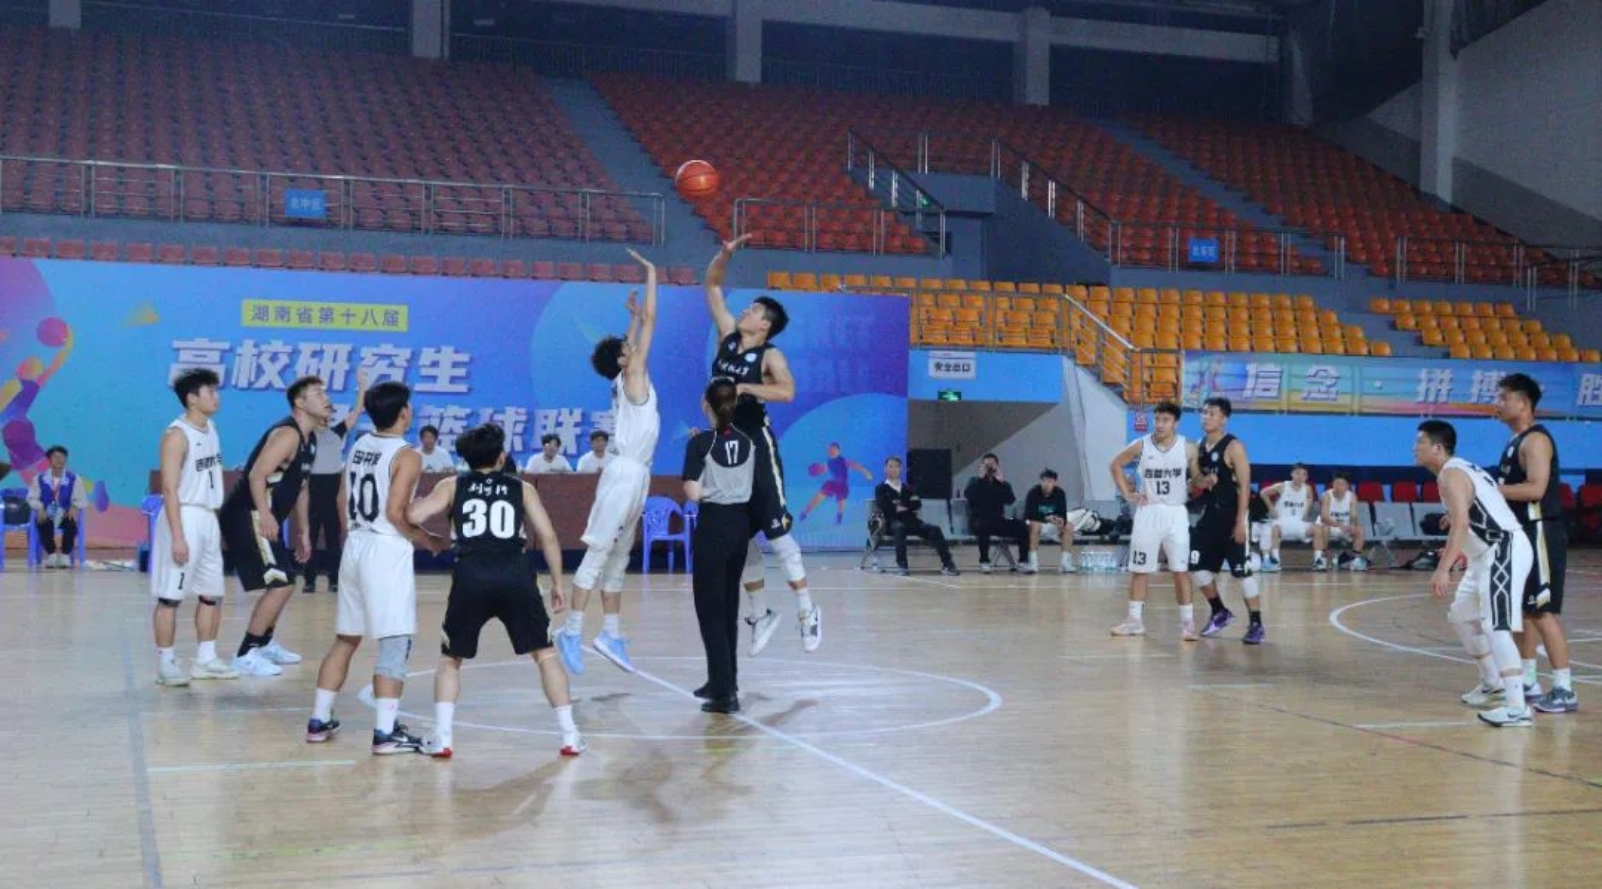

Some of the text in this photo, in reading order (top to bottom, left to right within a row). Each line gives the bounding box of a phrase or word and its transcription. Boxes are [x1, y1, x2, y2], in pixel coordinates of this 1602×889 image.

[251, 304, 402, 328] 湖南省第十八届
[168, 337, 471, 394] 高校研究生
[724, 440, 739, 466] 17
[207, 470, 215, 490] 1
[1155, 481, 1171, 496] 13
[348, 472, 379, 523] 10
[462, 498, 516, 540] 30
[1132, 550, 1148, 566] 13
